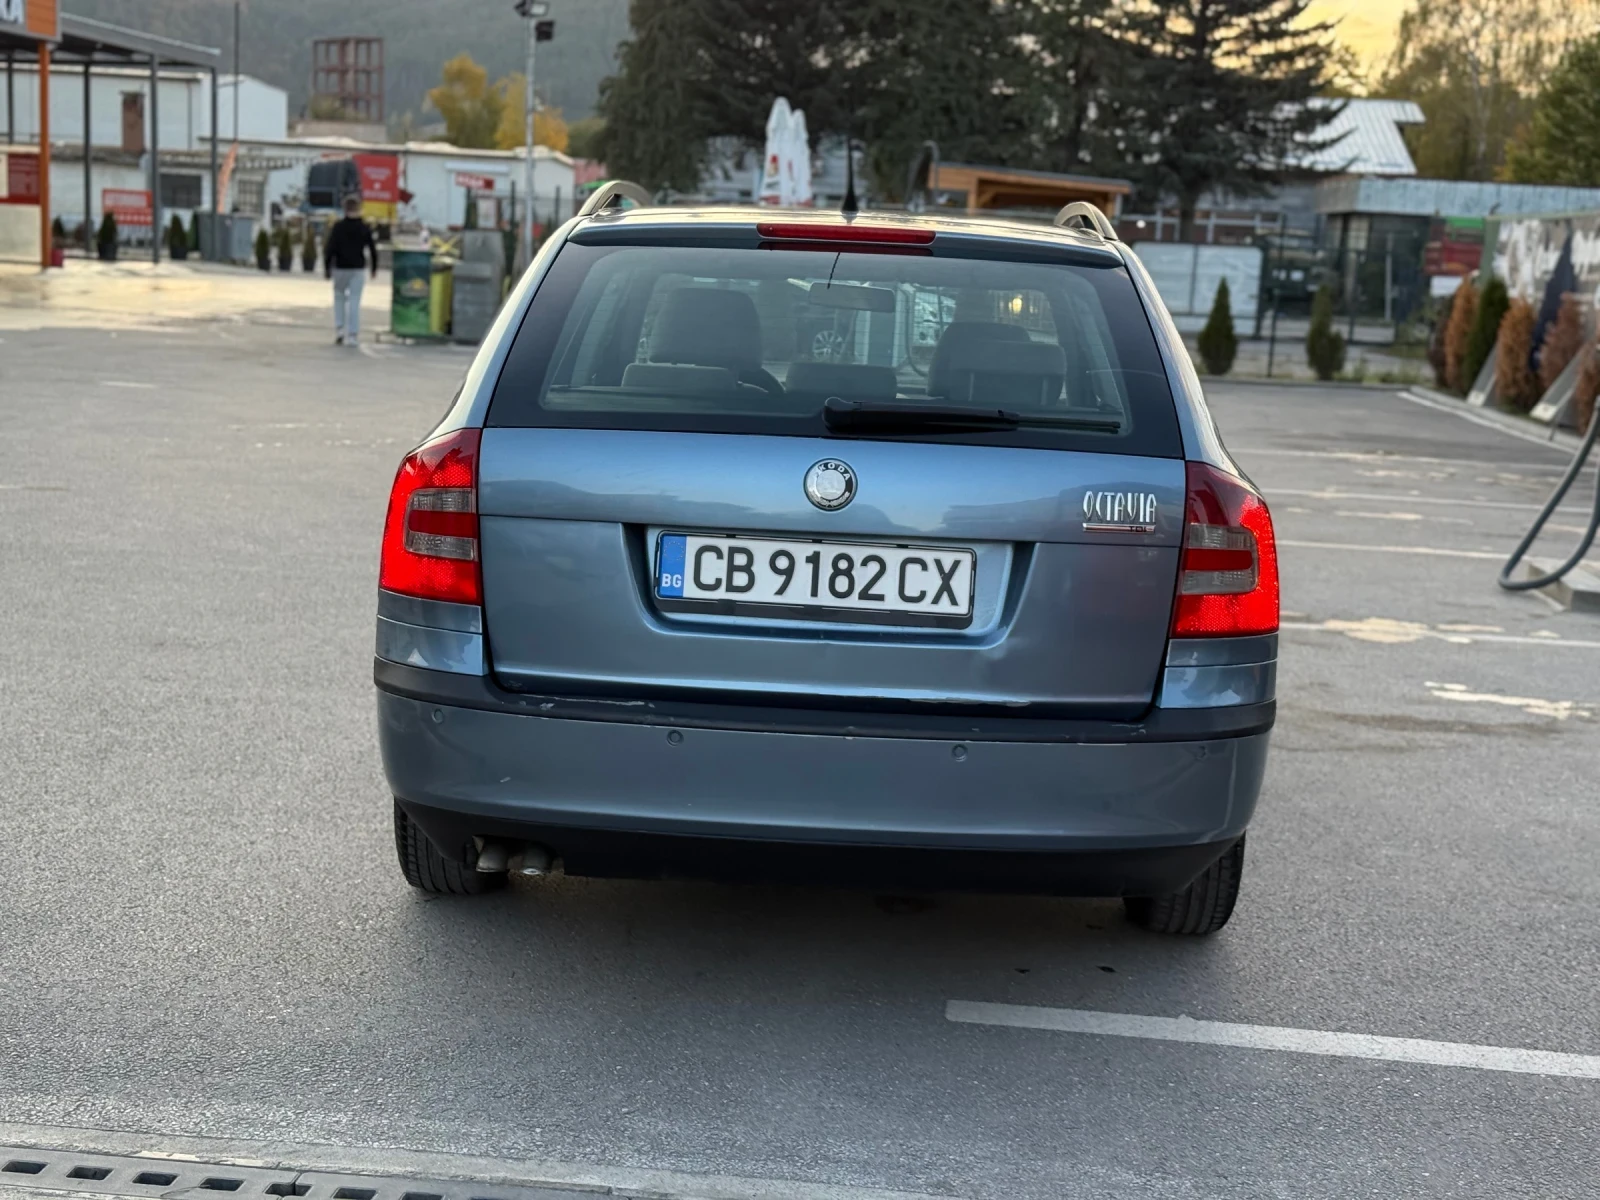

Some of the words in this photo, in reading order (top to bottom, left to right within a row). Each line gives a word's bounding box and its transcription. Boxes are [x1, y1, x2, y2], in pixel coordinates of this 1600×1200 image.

[1083, 490, 1157, 523] OCTAVIA
[661, 573, 682, 588] BG
[693, 544, 756, 593] CB
[769, 549, 887, 601] 9182
[897, 557, 962, 606] CX
